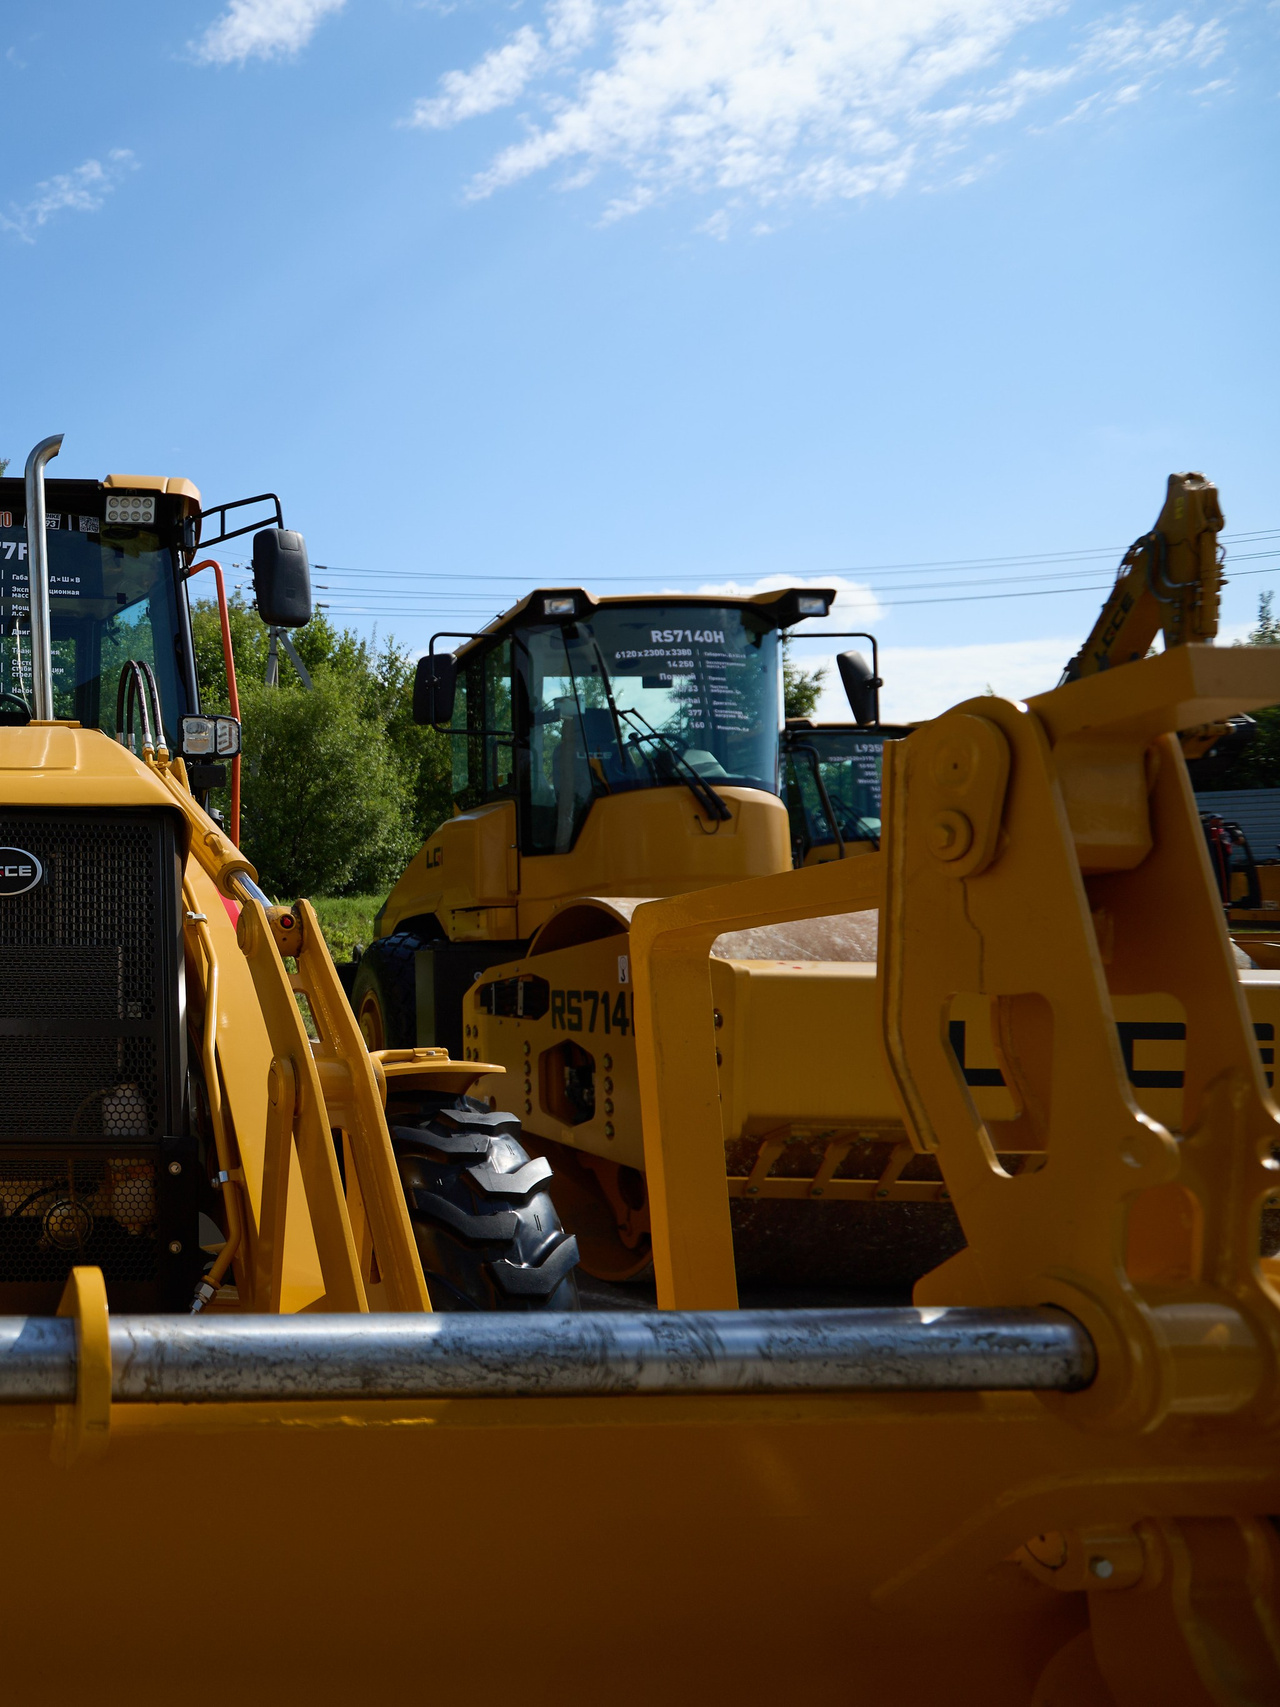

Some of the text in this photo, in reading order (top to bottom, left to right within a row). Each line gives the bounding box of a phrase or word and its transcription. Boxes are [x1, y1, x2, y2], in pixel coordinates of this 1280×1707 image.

[651, 630, 725, 644] RS7140H
[688, 709, 703, 717] 377
[690, 721, 705, 729] 160
[855, 744, 883, 752] L935
[551, 990, 635, 1037] RS714
